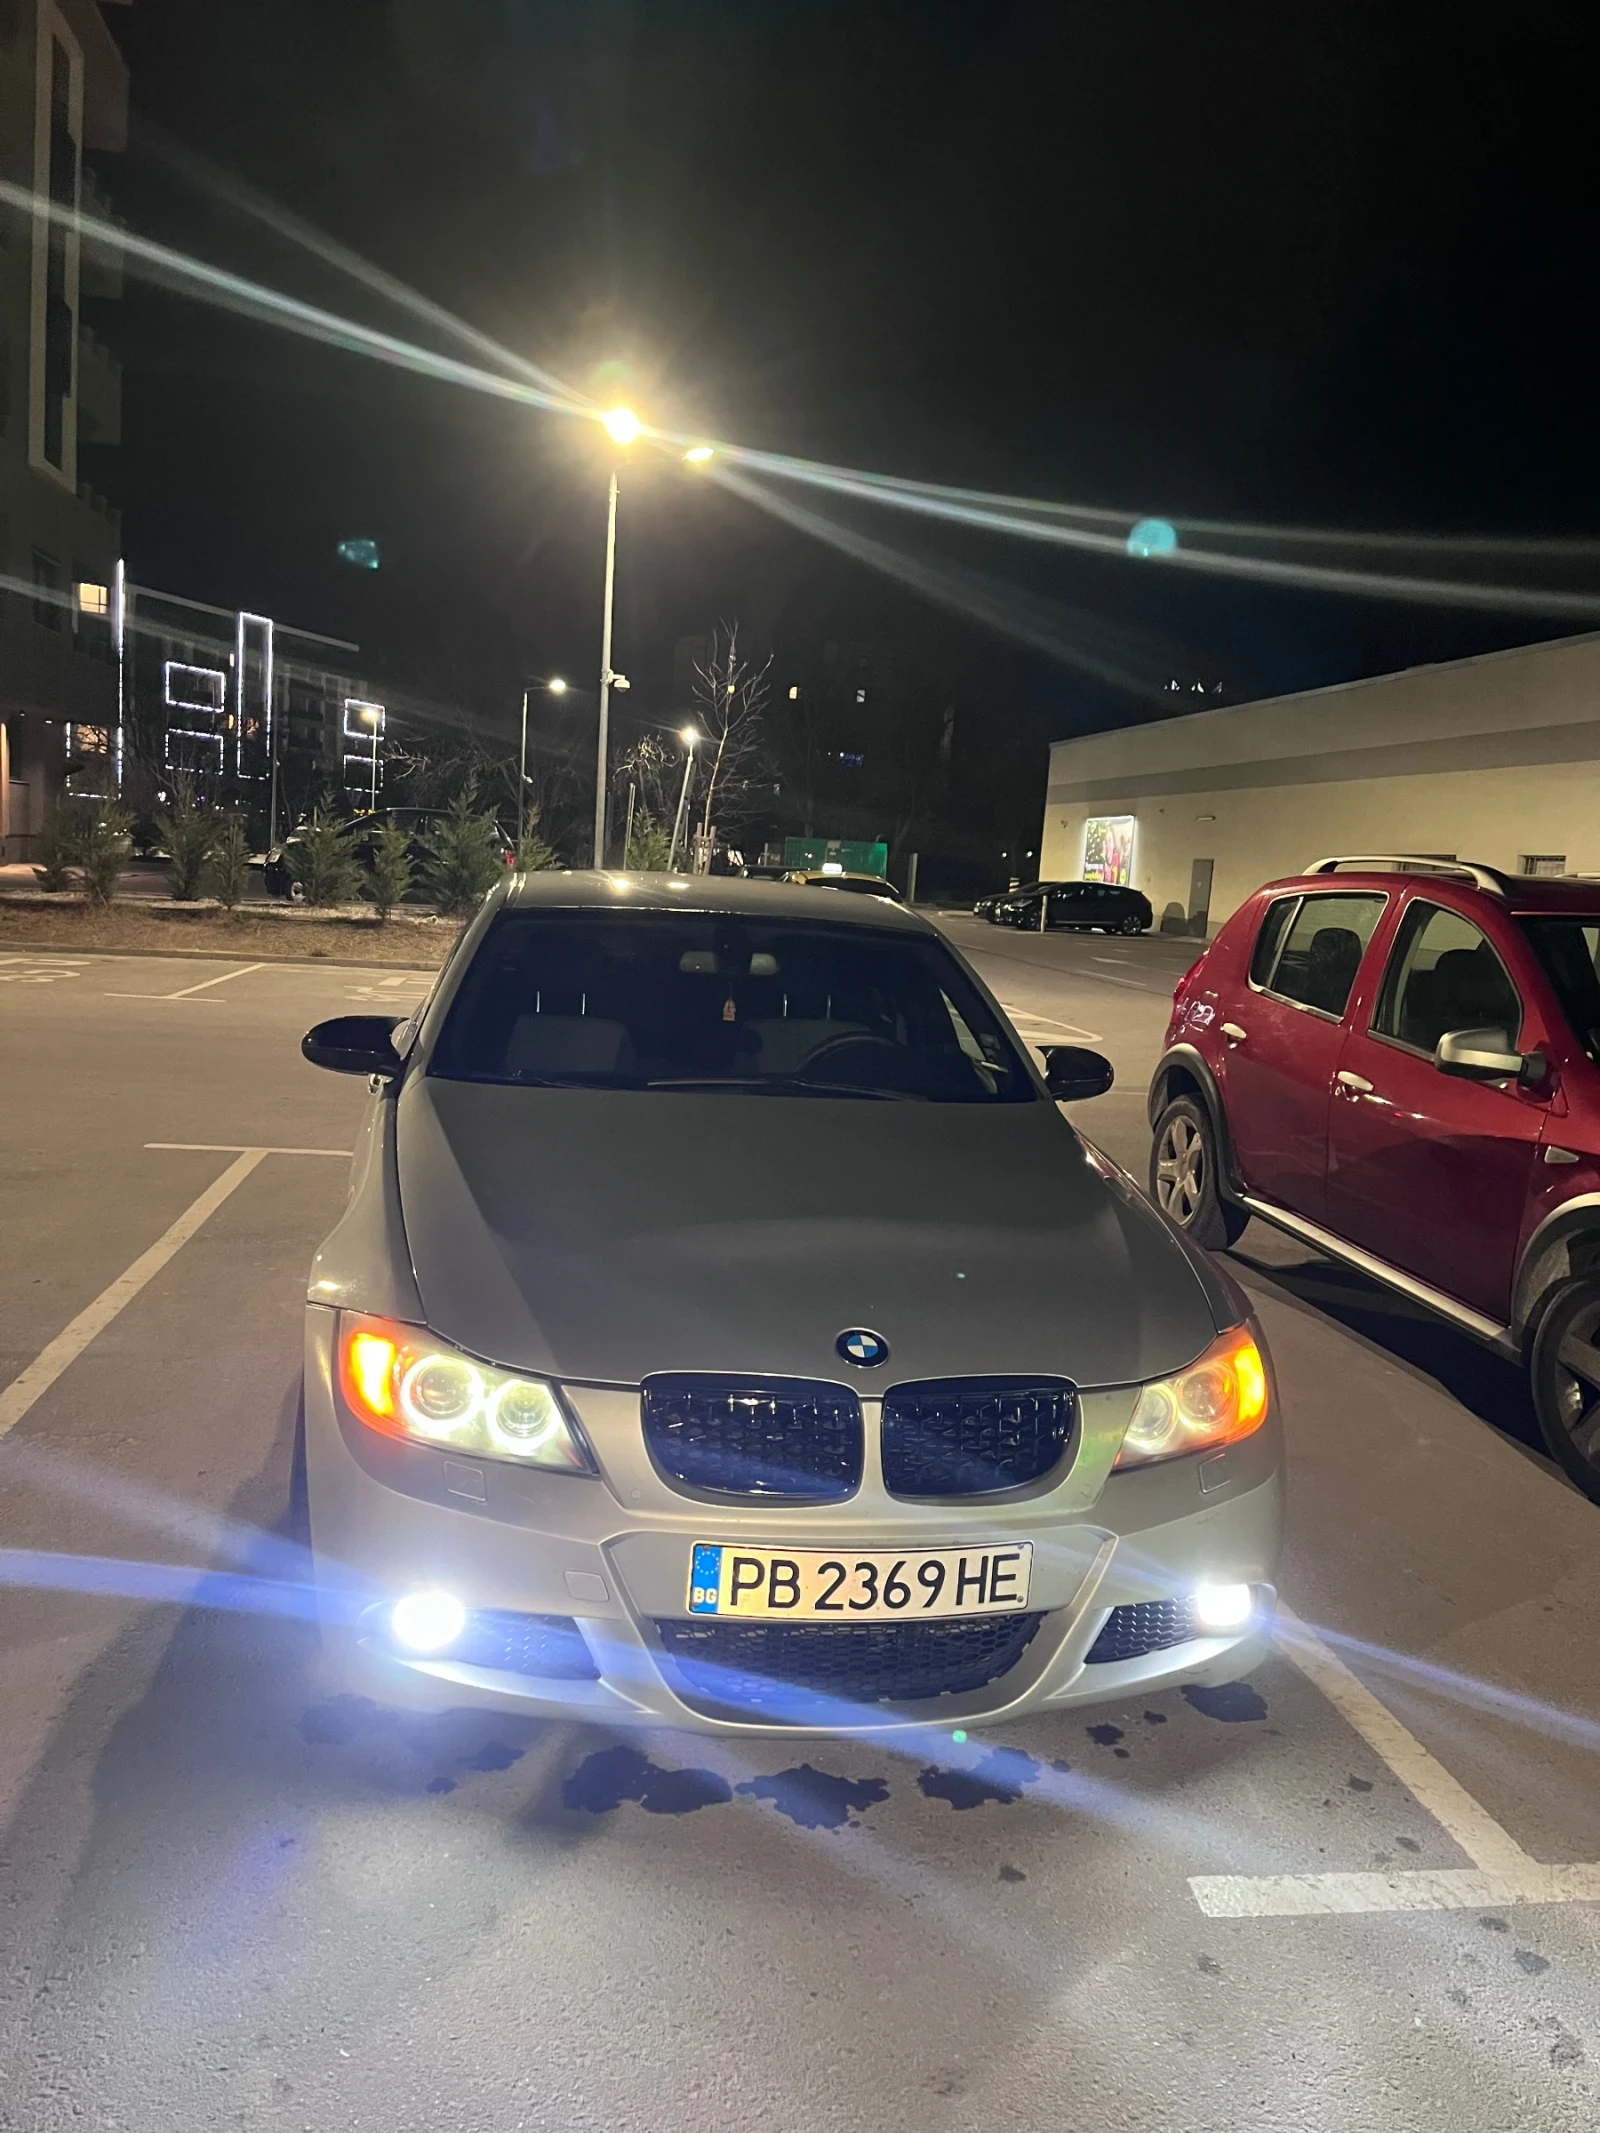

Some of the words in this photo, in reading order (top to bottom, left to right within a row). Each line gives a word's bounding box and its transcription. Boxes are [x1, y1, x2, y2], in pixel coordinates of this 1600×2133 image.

[693, 1587, 717, 1604] BG
[730, 1557, 801, 1608] PB
[814, 1560, 946, 1611] 2369
[955, 1553, 1020, 1605] HE
